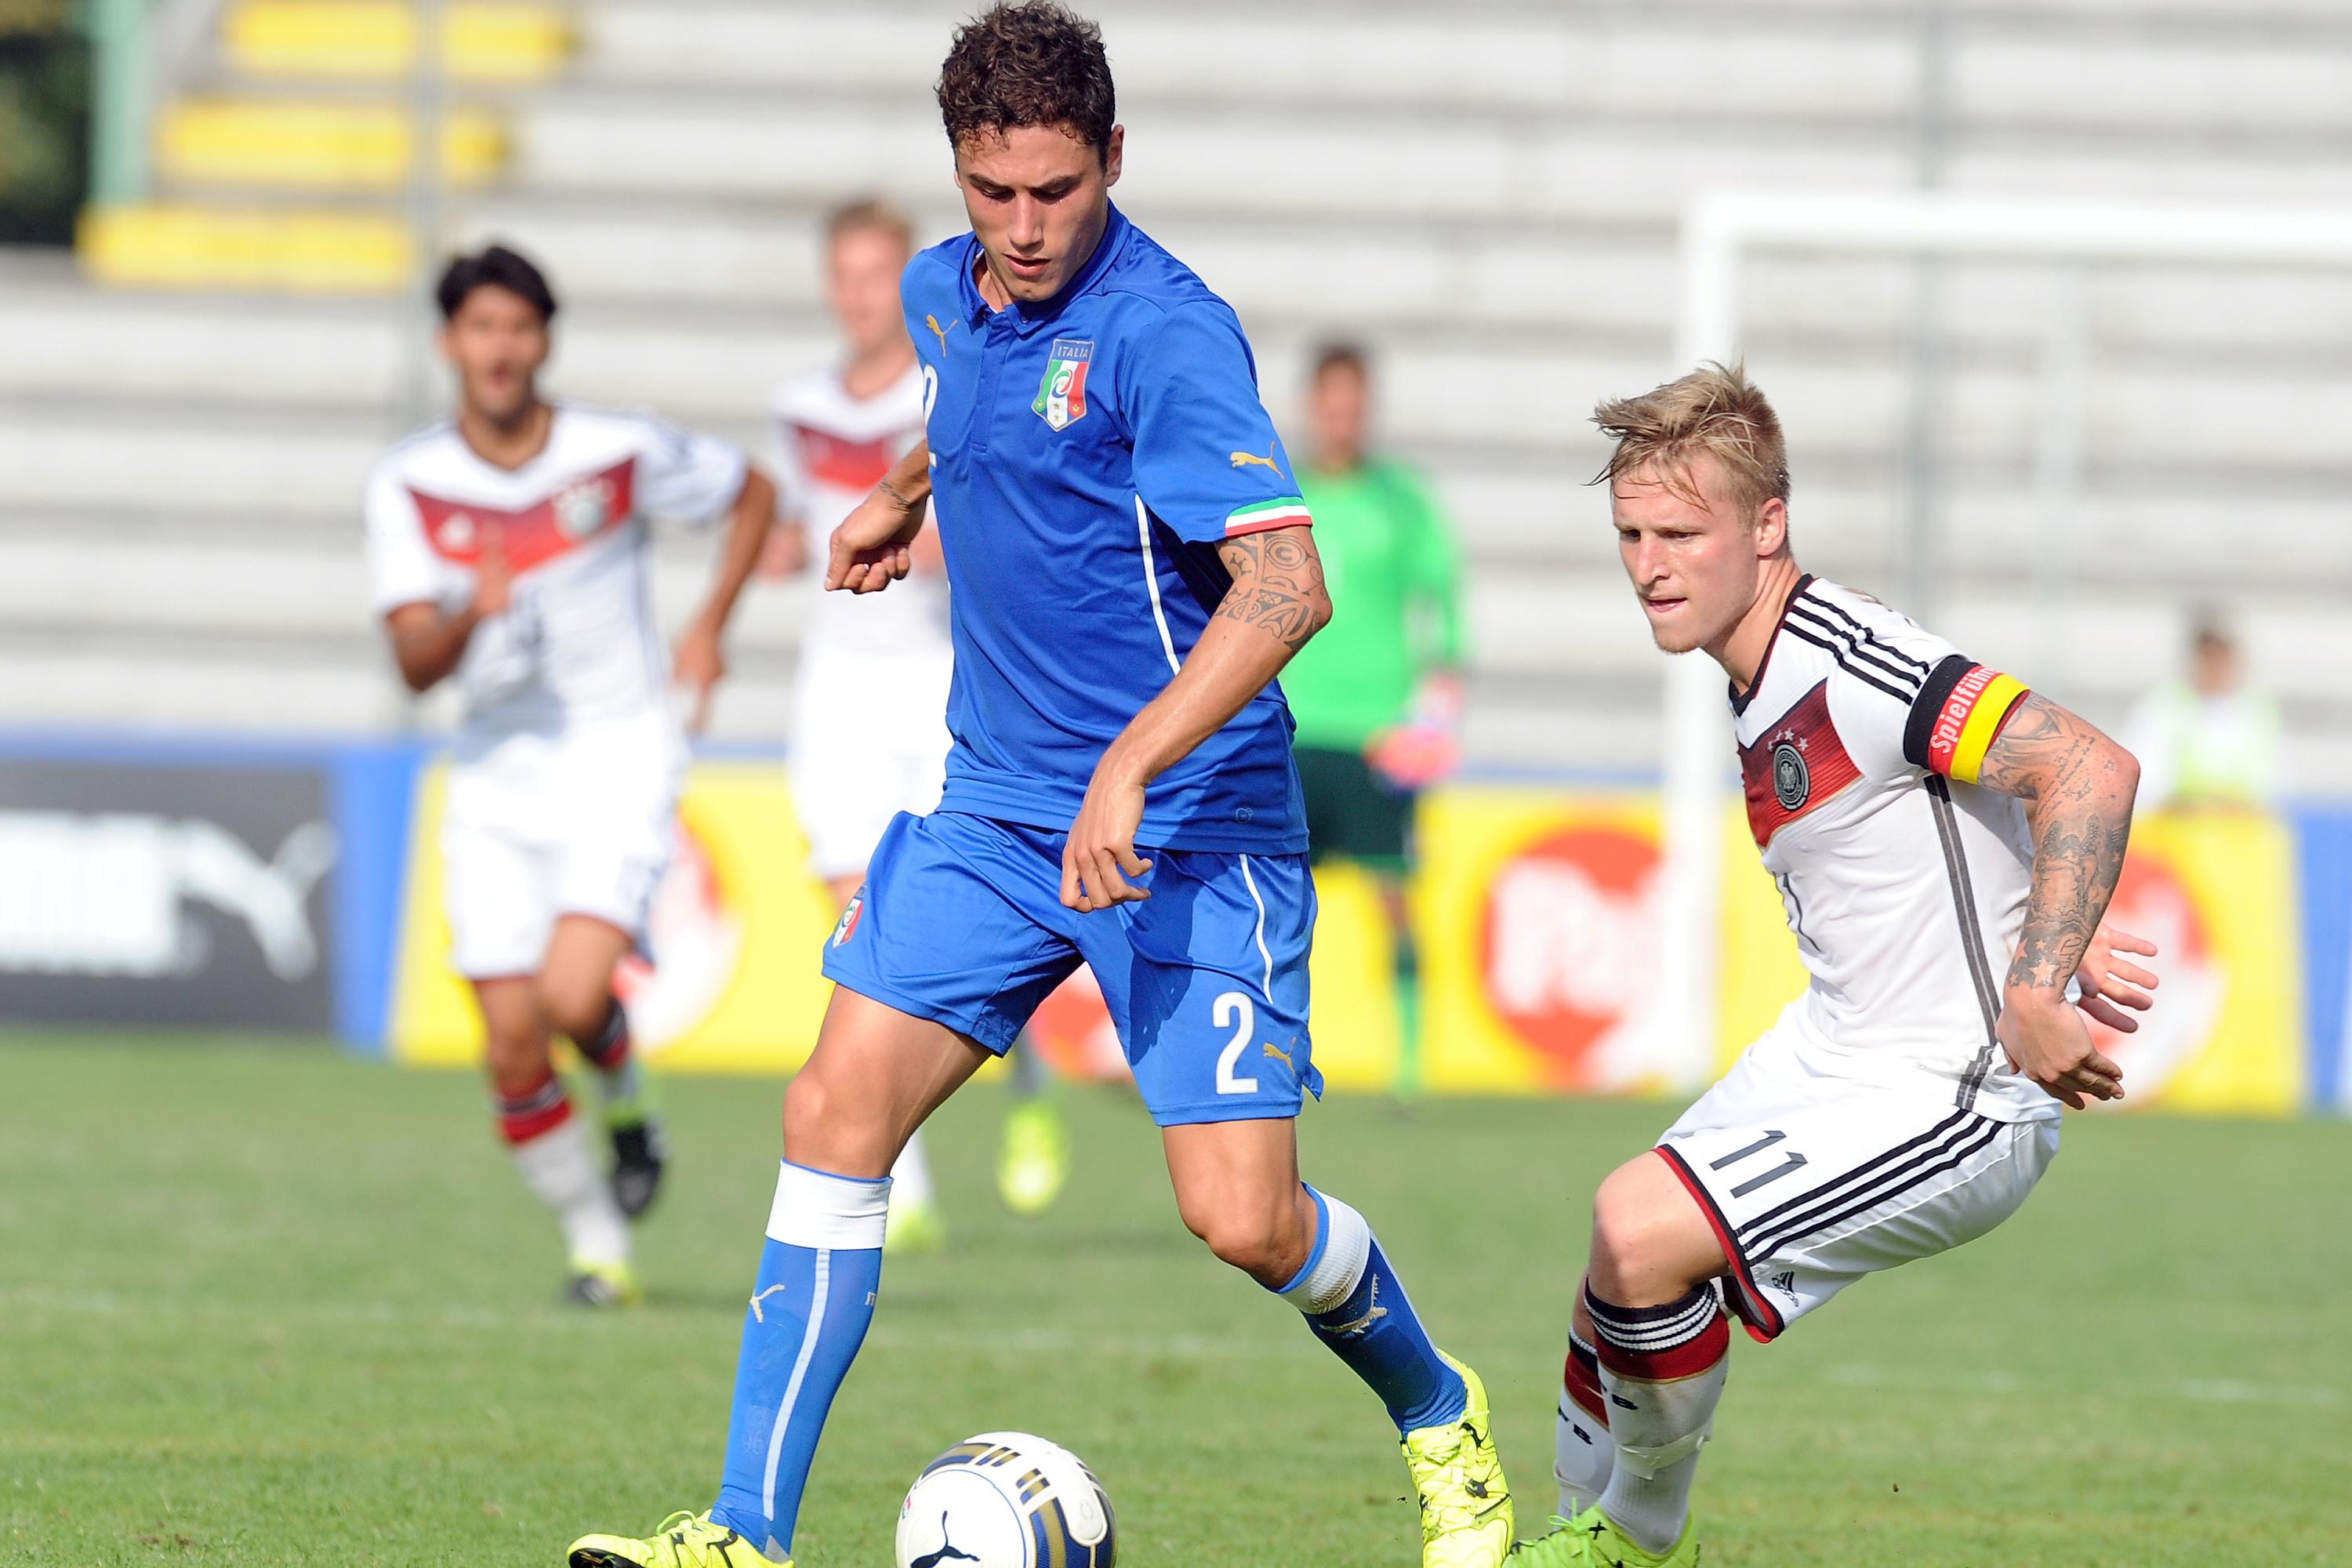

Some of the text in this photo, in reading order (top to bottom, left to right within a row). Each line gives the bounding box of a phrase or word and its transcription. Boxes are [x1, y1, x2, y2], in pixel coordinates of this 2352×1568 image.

[1057, 346, 1088, 358] ITALIA
[1213, 991, 1258, 1094] 2
[1708, 1130, 1808, 1199] 11
